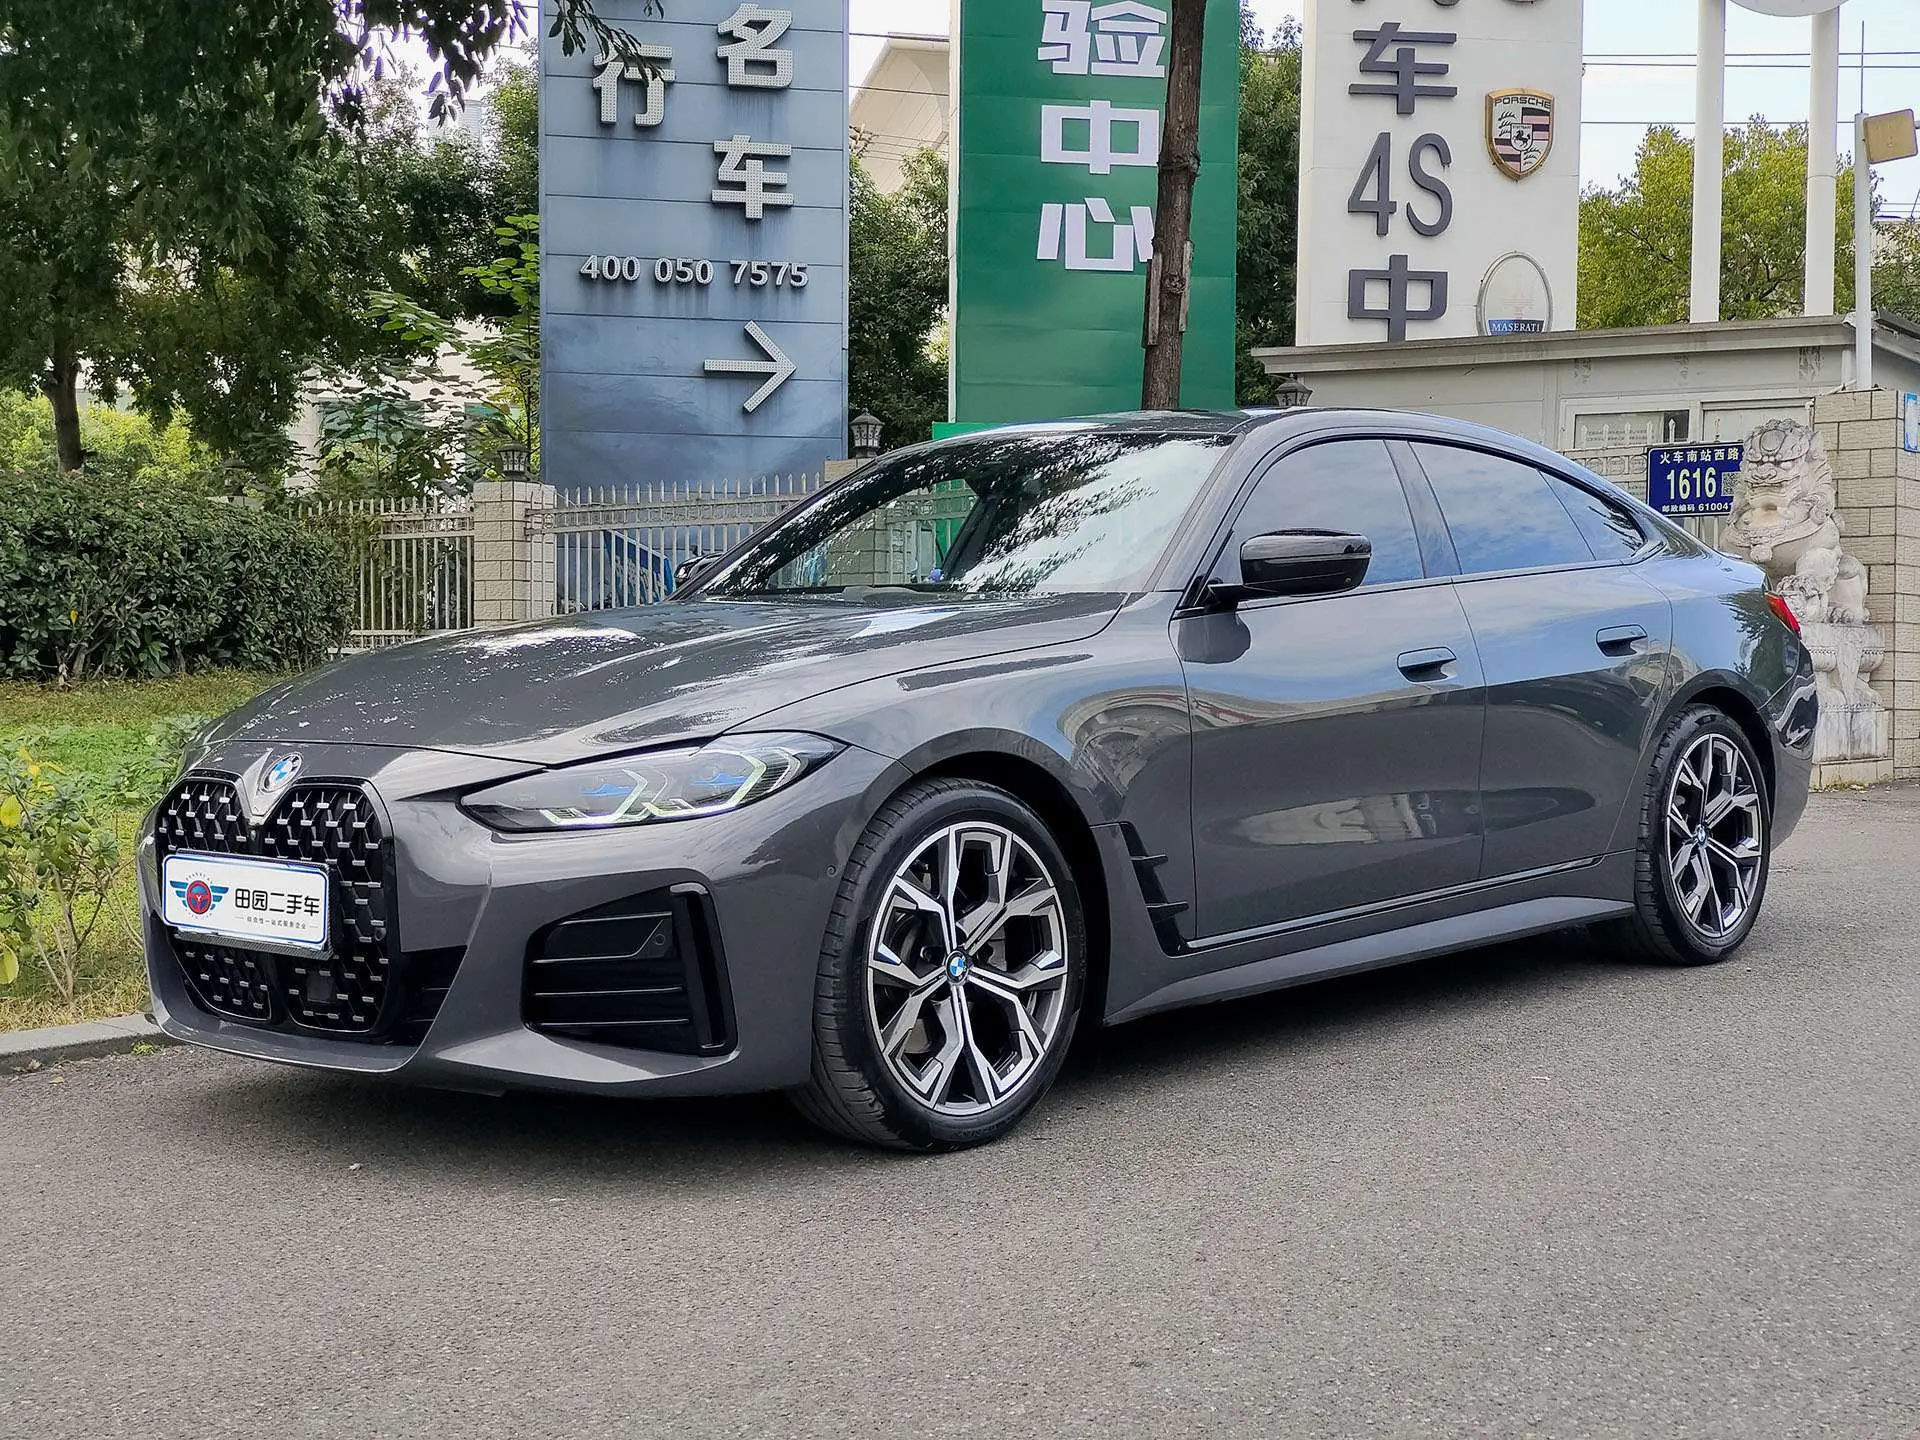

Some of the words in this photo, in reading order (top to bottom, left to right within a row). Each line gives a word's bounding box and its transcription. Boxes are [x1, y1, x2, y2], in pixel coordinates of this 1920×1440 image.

[592, 43, 675, 126] 行
[712, 3, 794, 220] 名车
[1494, 96, 1552, 109] PORSCHE
[1037, 0, 1167, 271] 验中心
[580, 255, 641, 282] 400
[654, 257, 714, 285] 050
[730, 260, 809, 288] 7575
[1491, 322, 1540, 332] MASERATI
[1659, 447, 1739, 464] 火车南站西路
[1666, 466, 1717, 500] 1616
[1662, 503, 1695, 513] 邮政编码
[235, 888, 320, 917] 田园二手车
